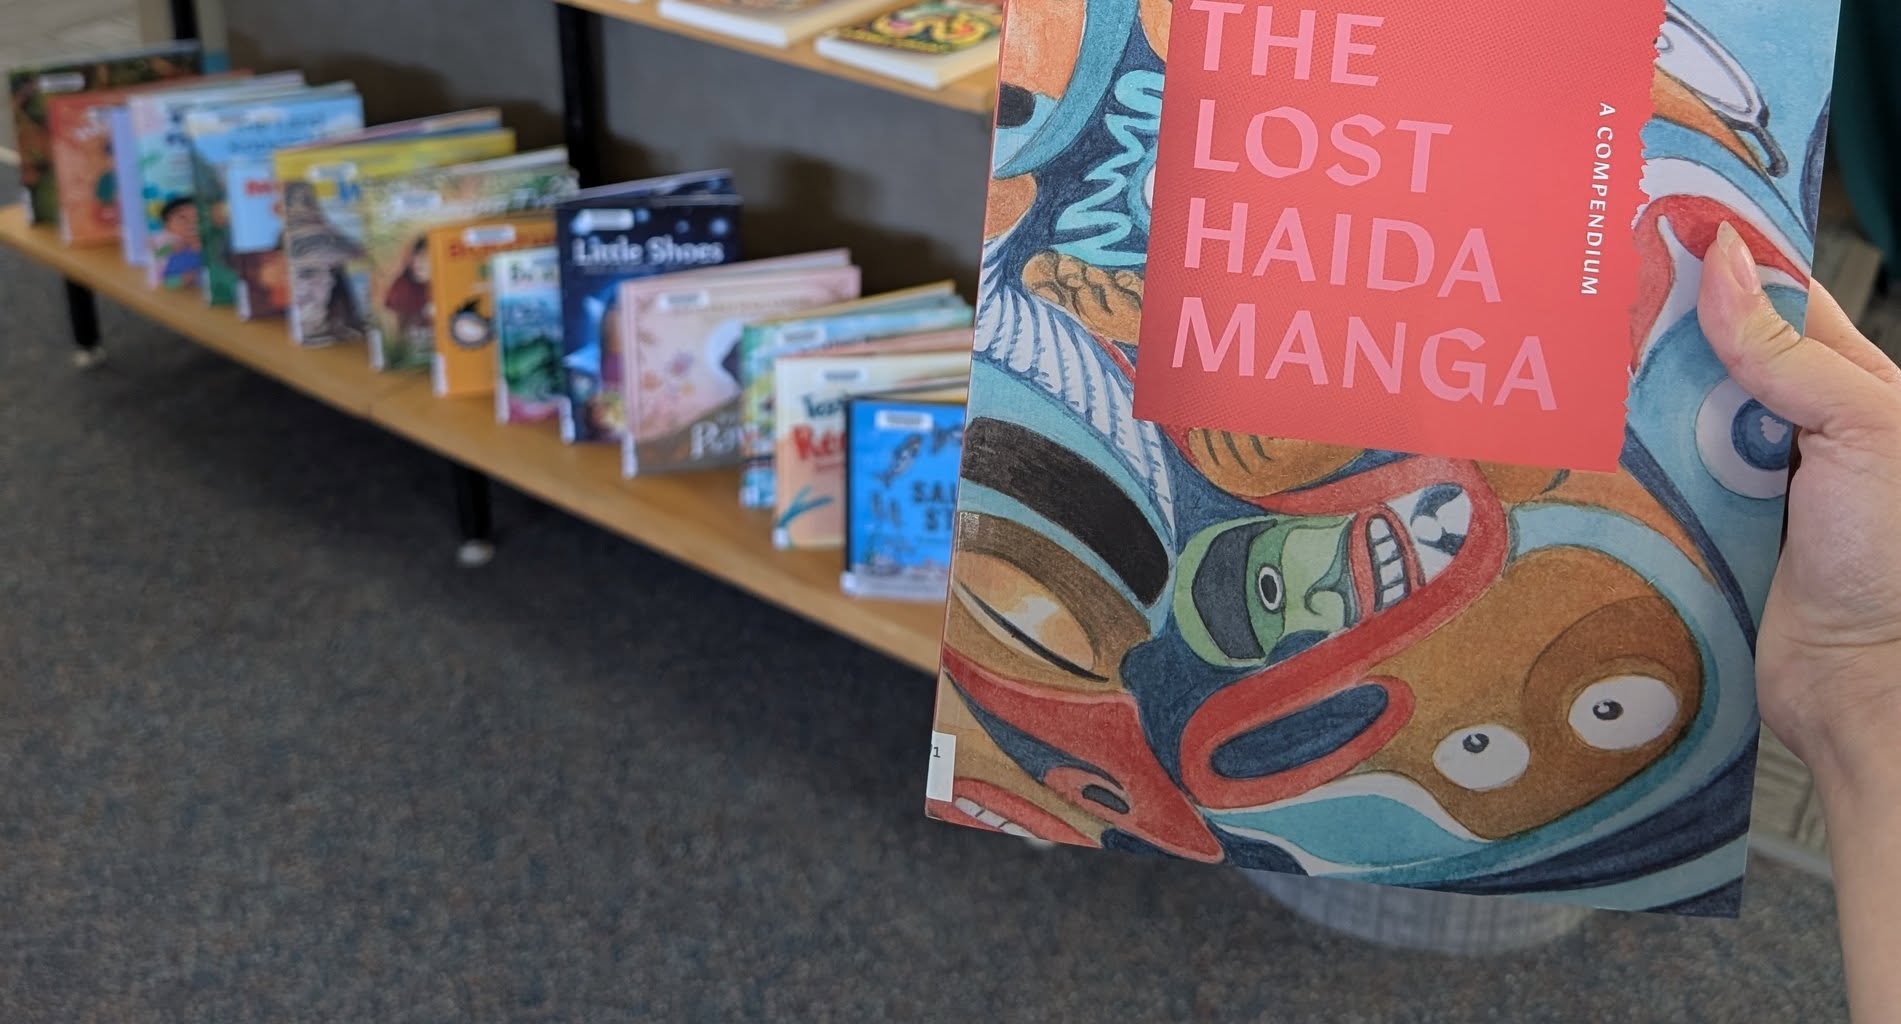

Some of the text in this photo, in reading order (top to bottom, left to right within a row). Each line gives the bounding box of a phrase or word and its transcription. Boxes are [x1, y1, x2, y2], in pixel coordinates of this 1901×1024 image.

[1189, 0, 1385, 87] THE
[1193, 99, 1453, 193] LOST
[1581, 102, 1616, 295] A COMPENDIUM
[570, 235, 643, 266] Little
[646, 234, 725, 266] Shoes
[1184, 197, 1502, 303] HAIDA
[1171, 296, 1558, 411] MANGA
